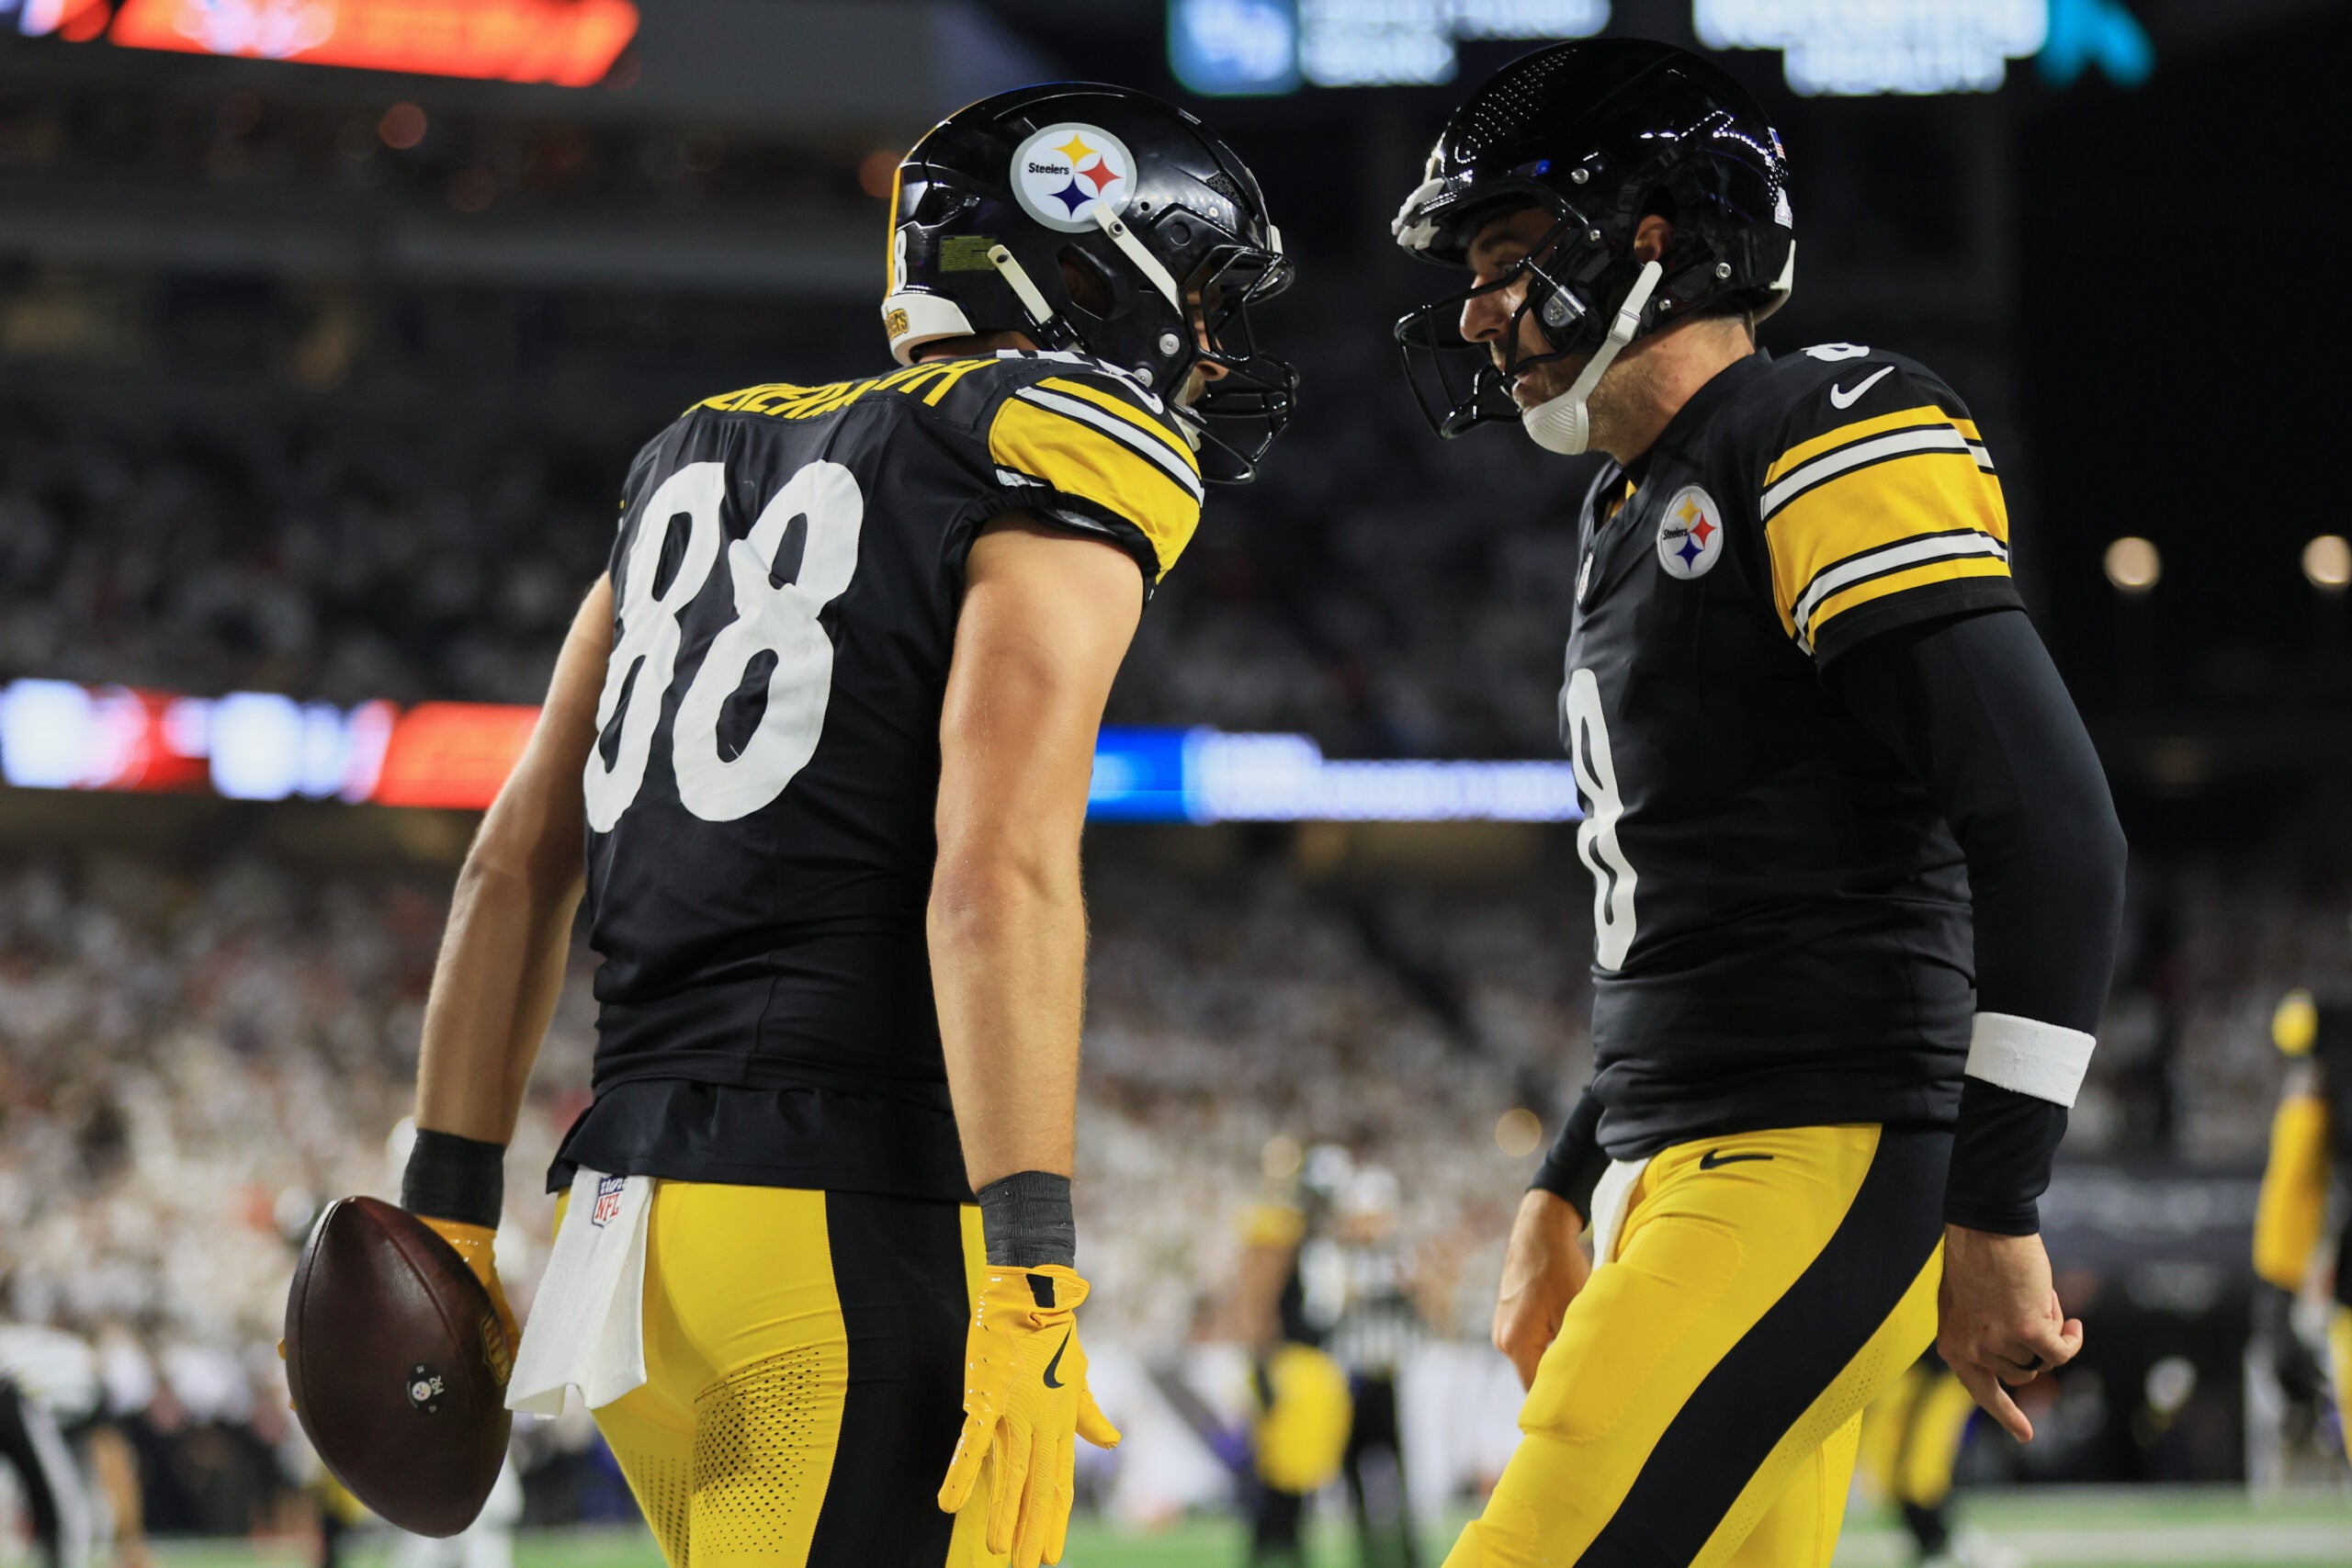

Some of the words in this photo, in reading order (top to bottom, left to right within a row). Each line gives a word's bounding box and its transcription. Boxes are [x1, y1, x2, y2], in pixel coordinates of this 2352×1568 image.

[1028, 162, 1070, 175] Steelers
[1663, 526, 1689, 540] Steelers
[583, 459, 864, 834] 88
[594, 1192, 620, 1222] NFL
